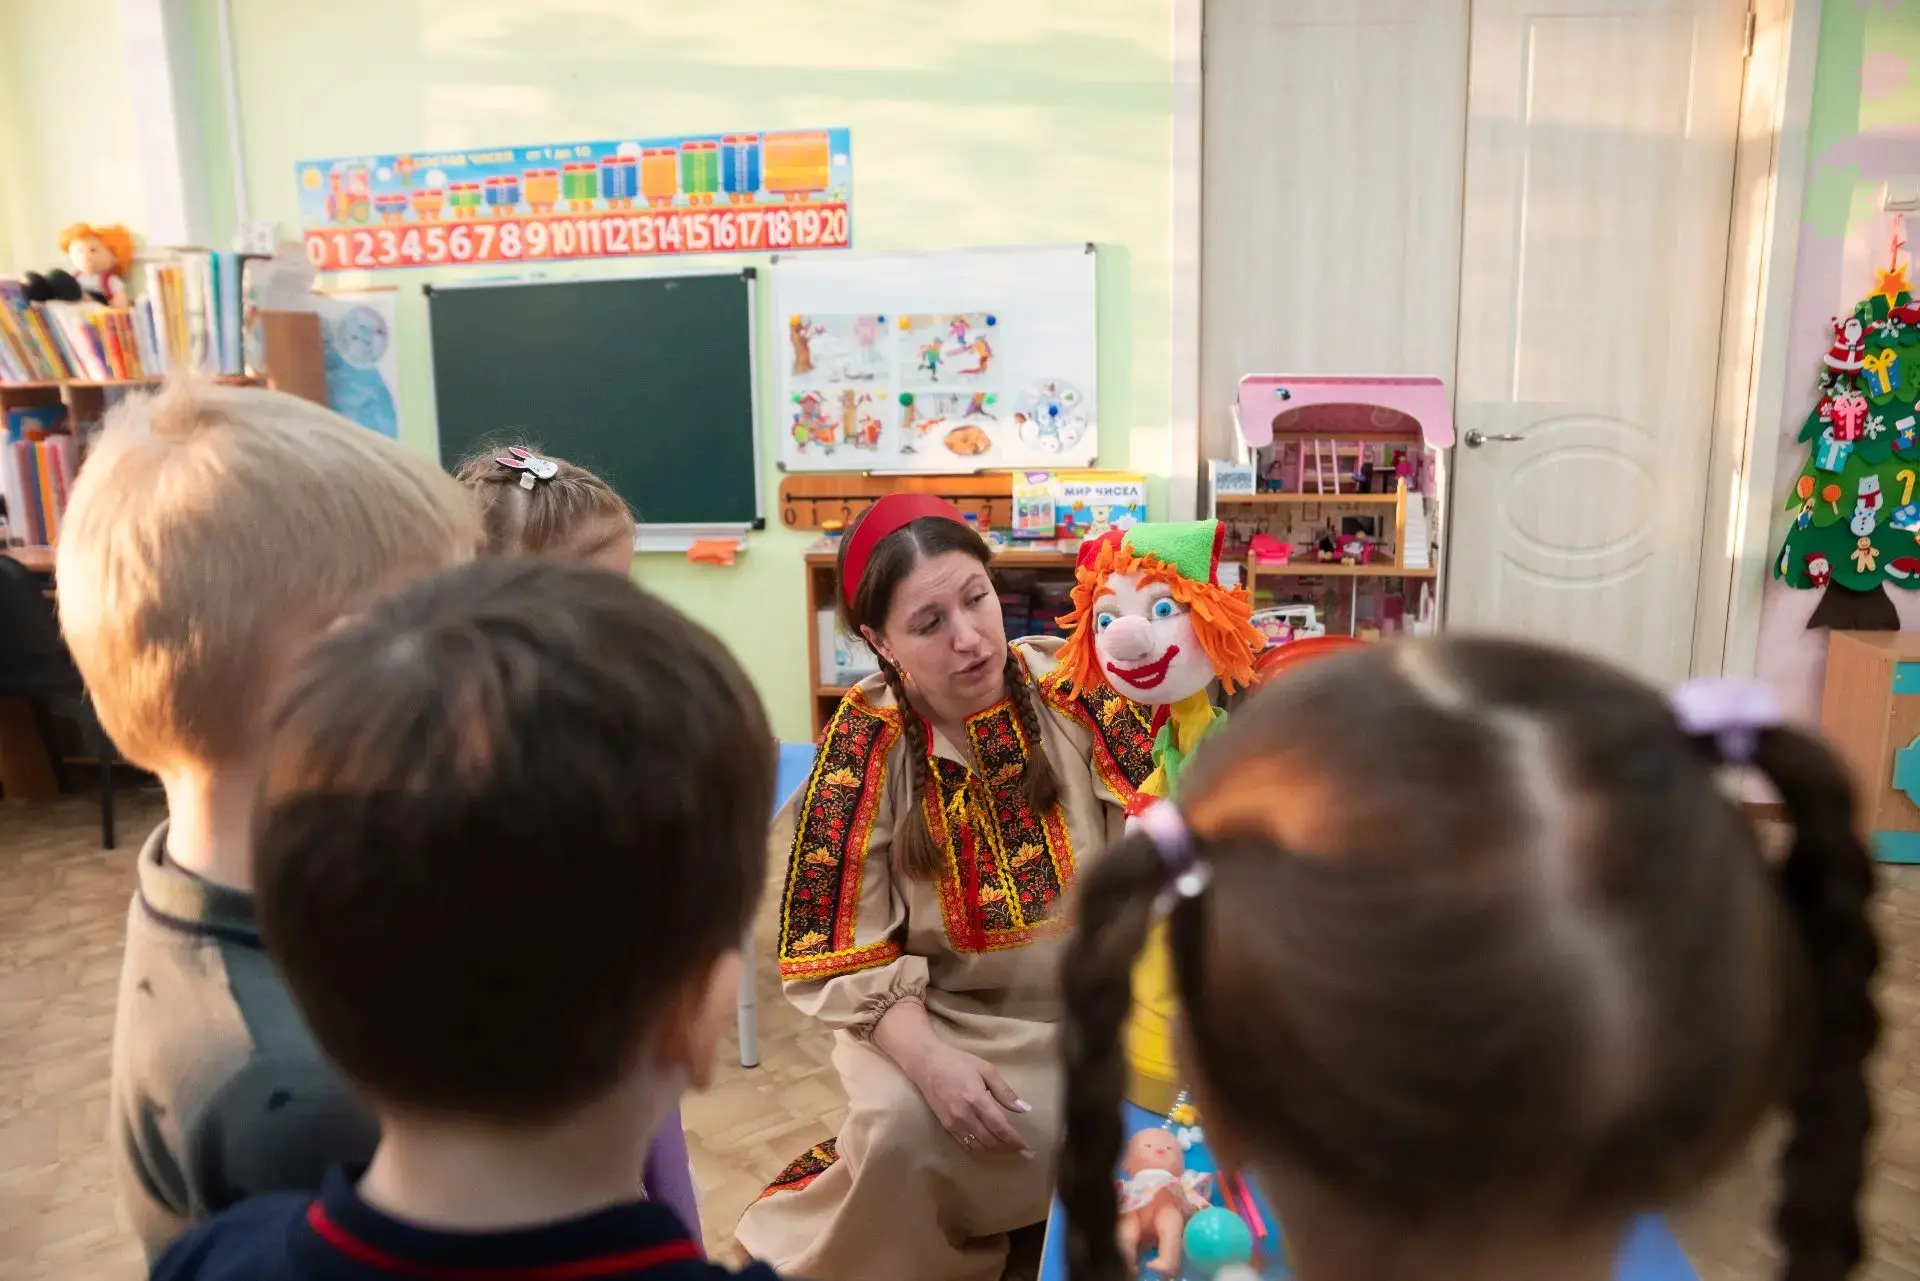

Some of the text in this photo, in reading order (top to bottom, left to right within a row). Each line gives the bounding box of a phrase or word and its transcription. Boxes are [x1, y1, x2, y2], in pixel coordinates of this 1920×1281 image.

[306, 208, 847, 266] 0 1 2 3 4 5 6 7 8 9 10 11 12 13 14 15 16 17 18 19 20
[1064, 486, 1139, 497] МИР ЧИСЕЛ
[784, 507, 797, 526] 0
[812, 507, 818, 526] 1
